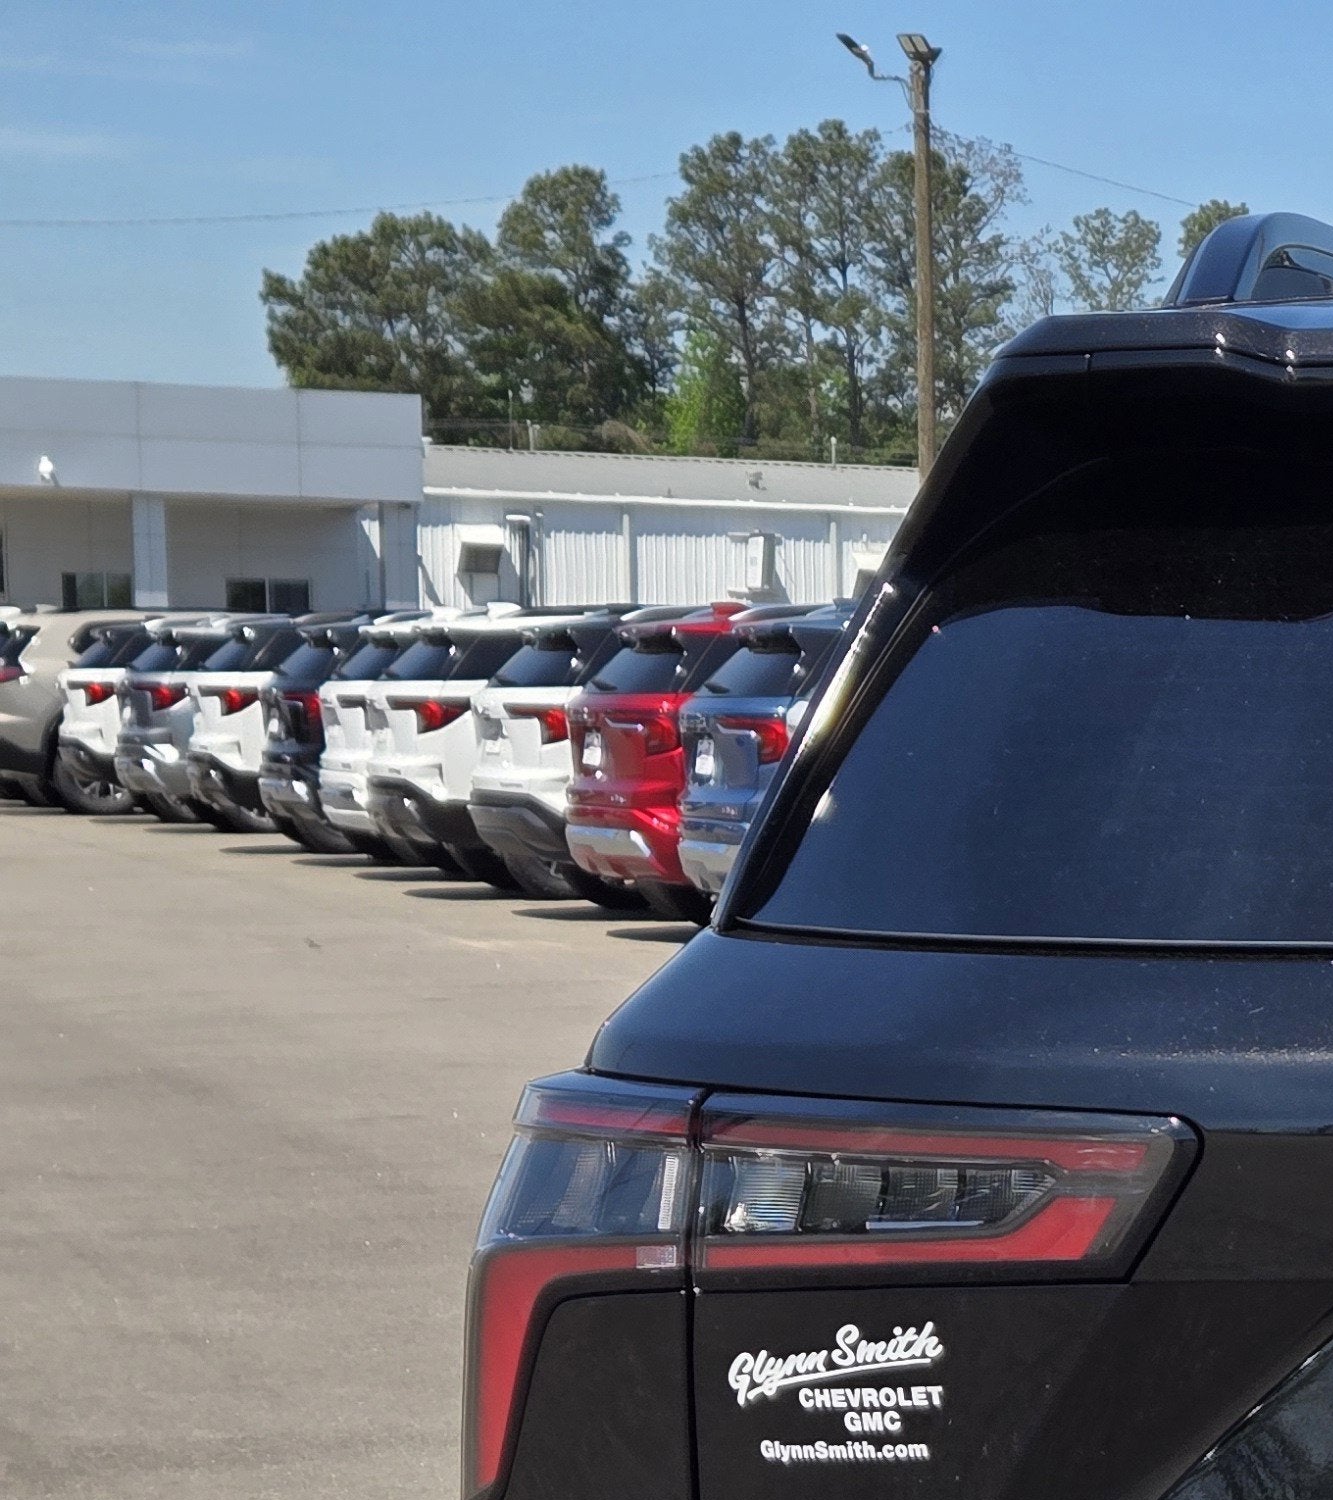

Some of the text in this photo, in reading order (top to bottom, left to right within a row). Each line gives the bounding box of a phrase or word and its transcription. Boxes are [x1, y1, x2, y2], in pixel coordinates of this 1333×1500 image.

[728, 1321, 943, 1407] Glynn Smith
[799, 1386, 943, 1409] CHEVROLET
[843, 1411, 902, 1432] GMC
[760, 1440, 929, 1464] GlynnSmith.com
